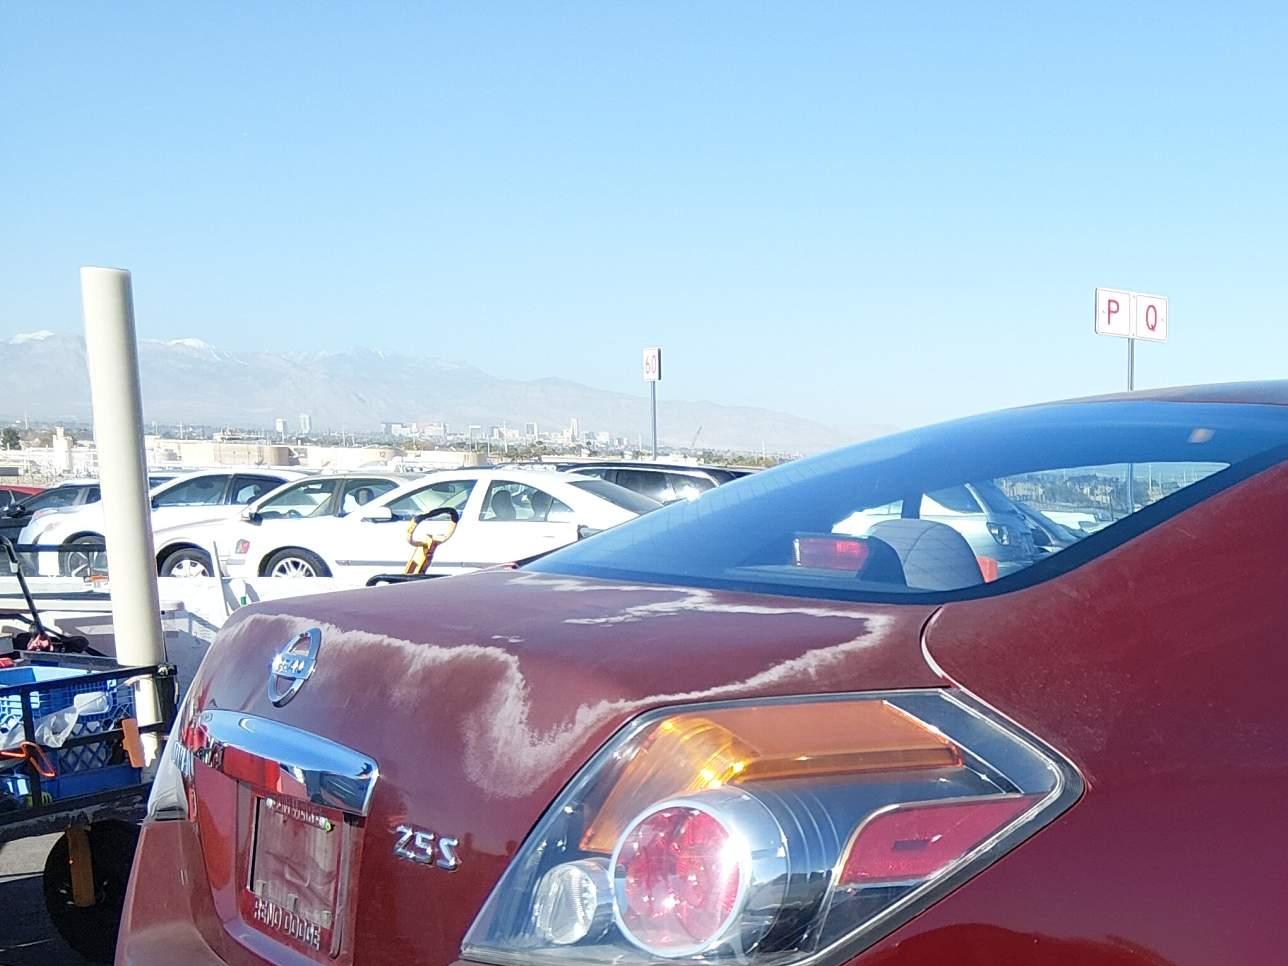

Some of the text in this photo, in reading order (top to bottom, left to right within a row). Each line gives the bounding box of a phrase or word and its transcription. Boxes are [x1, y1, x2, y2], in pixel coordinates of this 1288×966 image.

[1107, 299, 1158, 332] P Q
[436, 837, 458, 870] S
